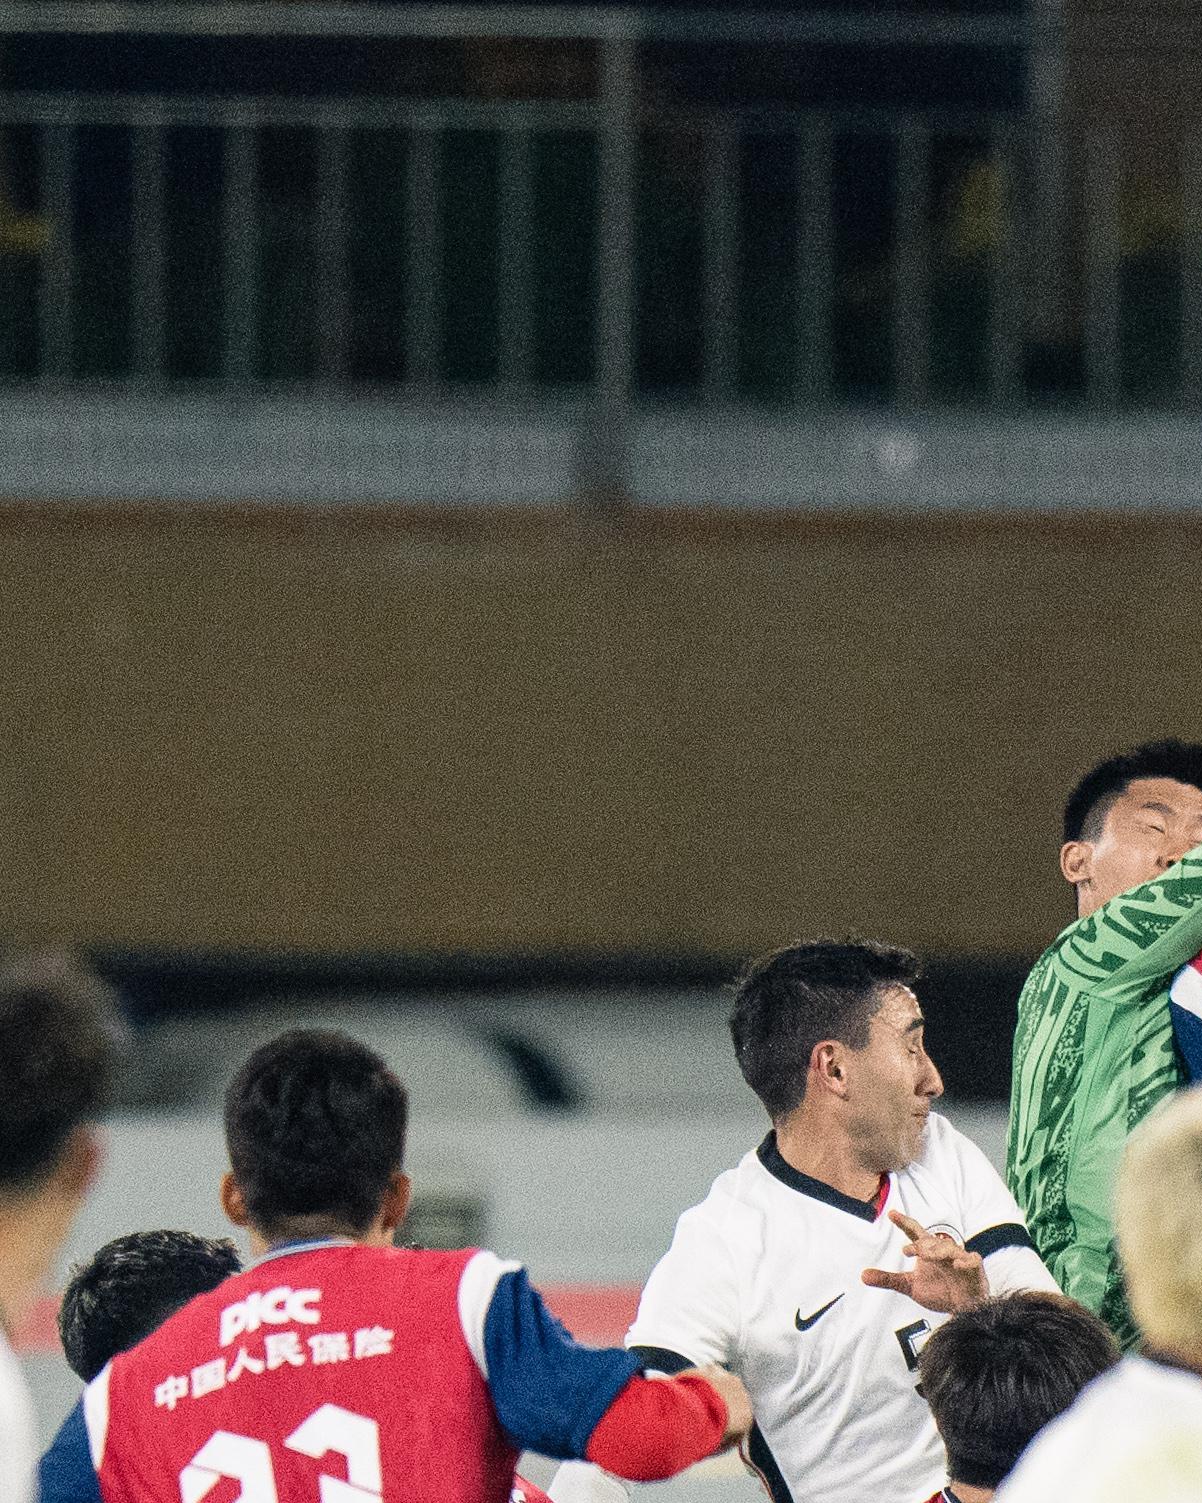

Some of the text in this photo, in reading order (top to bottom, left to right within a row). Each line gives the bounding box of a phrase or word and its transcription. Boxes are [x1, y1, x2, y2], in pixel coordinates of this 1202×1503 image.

[218, 1285, 323, 1349] PICC
[153, 1324, 396, 1412] 中国人民保险
